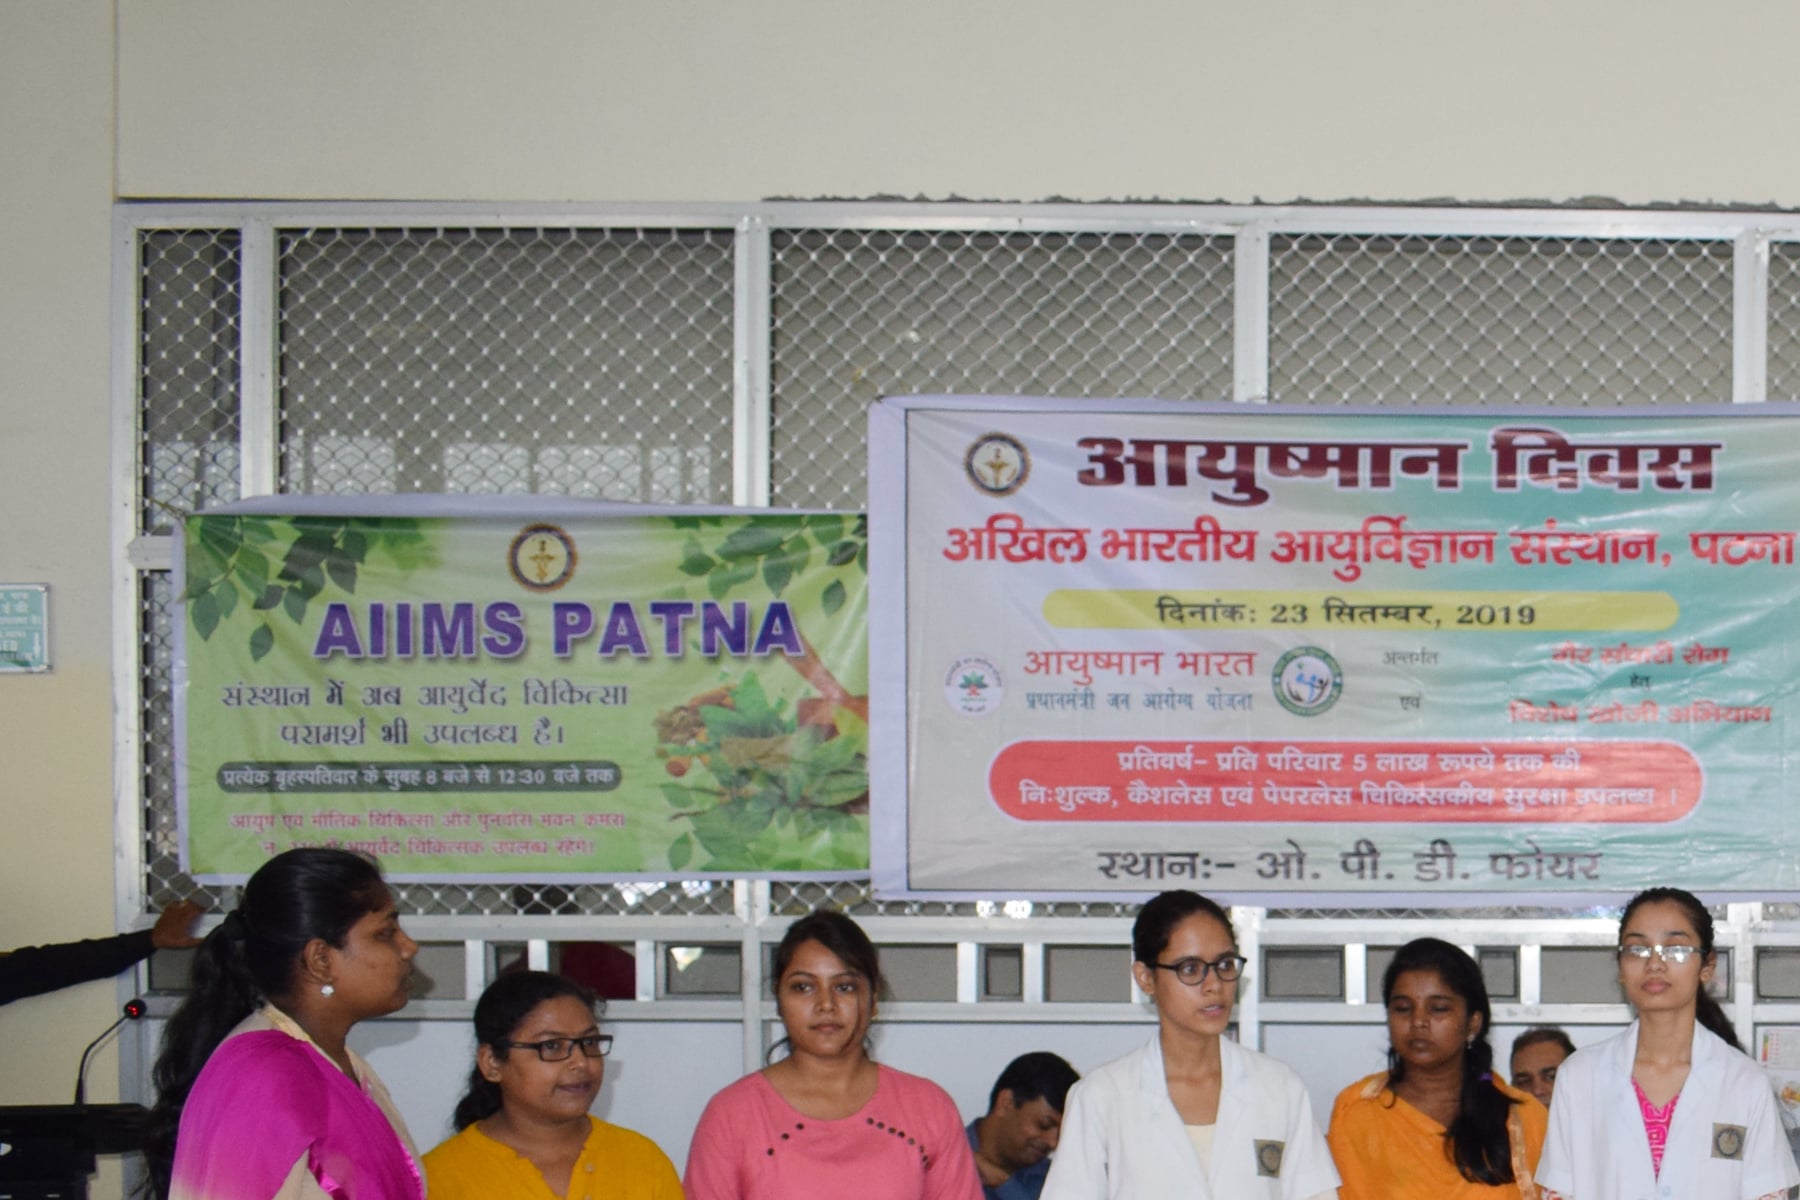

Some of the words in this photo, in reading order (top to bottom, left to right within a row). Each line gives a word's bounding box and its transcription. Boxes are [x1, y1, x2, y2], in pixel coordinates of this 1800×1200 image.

[1076, 436, 1468, 506] आयुष्मान
[1491, 428, 1723, 490] दिवस
[942, 513, 1091, 563] अखिल
[1100, 515, 1259, 563] भारतीय
[1270, 515, 1498, 583] आयुर्विज्ञान
[1508, 518, 1671, 568] संस्थान,
[1690, 531, 1799, 566] पटना
[1155, 597, 1257, 624] दिनांक:
[1270, 604, 1308, 624] 23
[1455, 606, 1536, 626] 2019
[312, 602, 526, 658] AIIMS
[551, 602, 805, 657] PATNA
[1024, 651, 1164, 686] आयुष्मान
[1176, 651, 1258, 676] भारत
[222, 681, 311, 707] संस्थान
[326, 678, 345, 707] में
[361, 686, 402, 706] अब
[522, 678, 629, 706] चिकित्सा
[1107, 693, 1131, 710] जन
[1206, 688, 1254, 710] योजना
[281, 718, 365, 744] परामर्श
[382, 718, 409, 744] भी
[423, 724, 519, 744] उपलब्ध
[1215, 746, 1259, 771] प्रति
[1266, 746, 1343, 771] परिवार
[1353, 754, 1368, 771] 5
[1375, 753, 1429, 771] लाख
[1503, 754, 1543, 772] तक
[1552, 749, 1581, 771] की
[362, 765, 379, 784] के
[384, 769, 420, 790] सुबह
[425, 771, 438, 784] 8
[474, 766, 491, 784] से
[584, 768, 615, 784] तक
[1128, 780, 1212, 804] कैशलेस
[1262, 780, 1352, 805] पेपरलेस
[1489, 839, 1602, 882] फोयर
